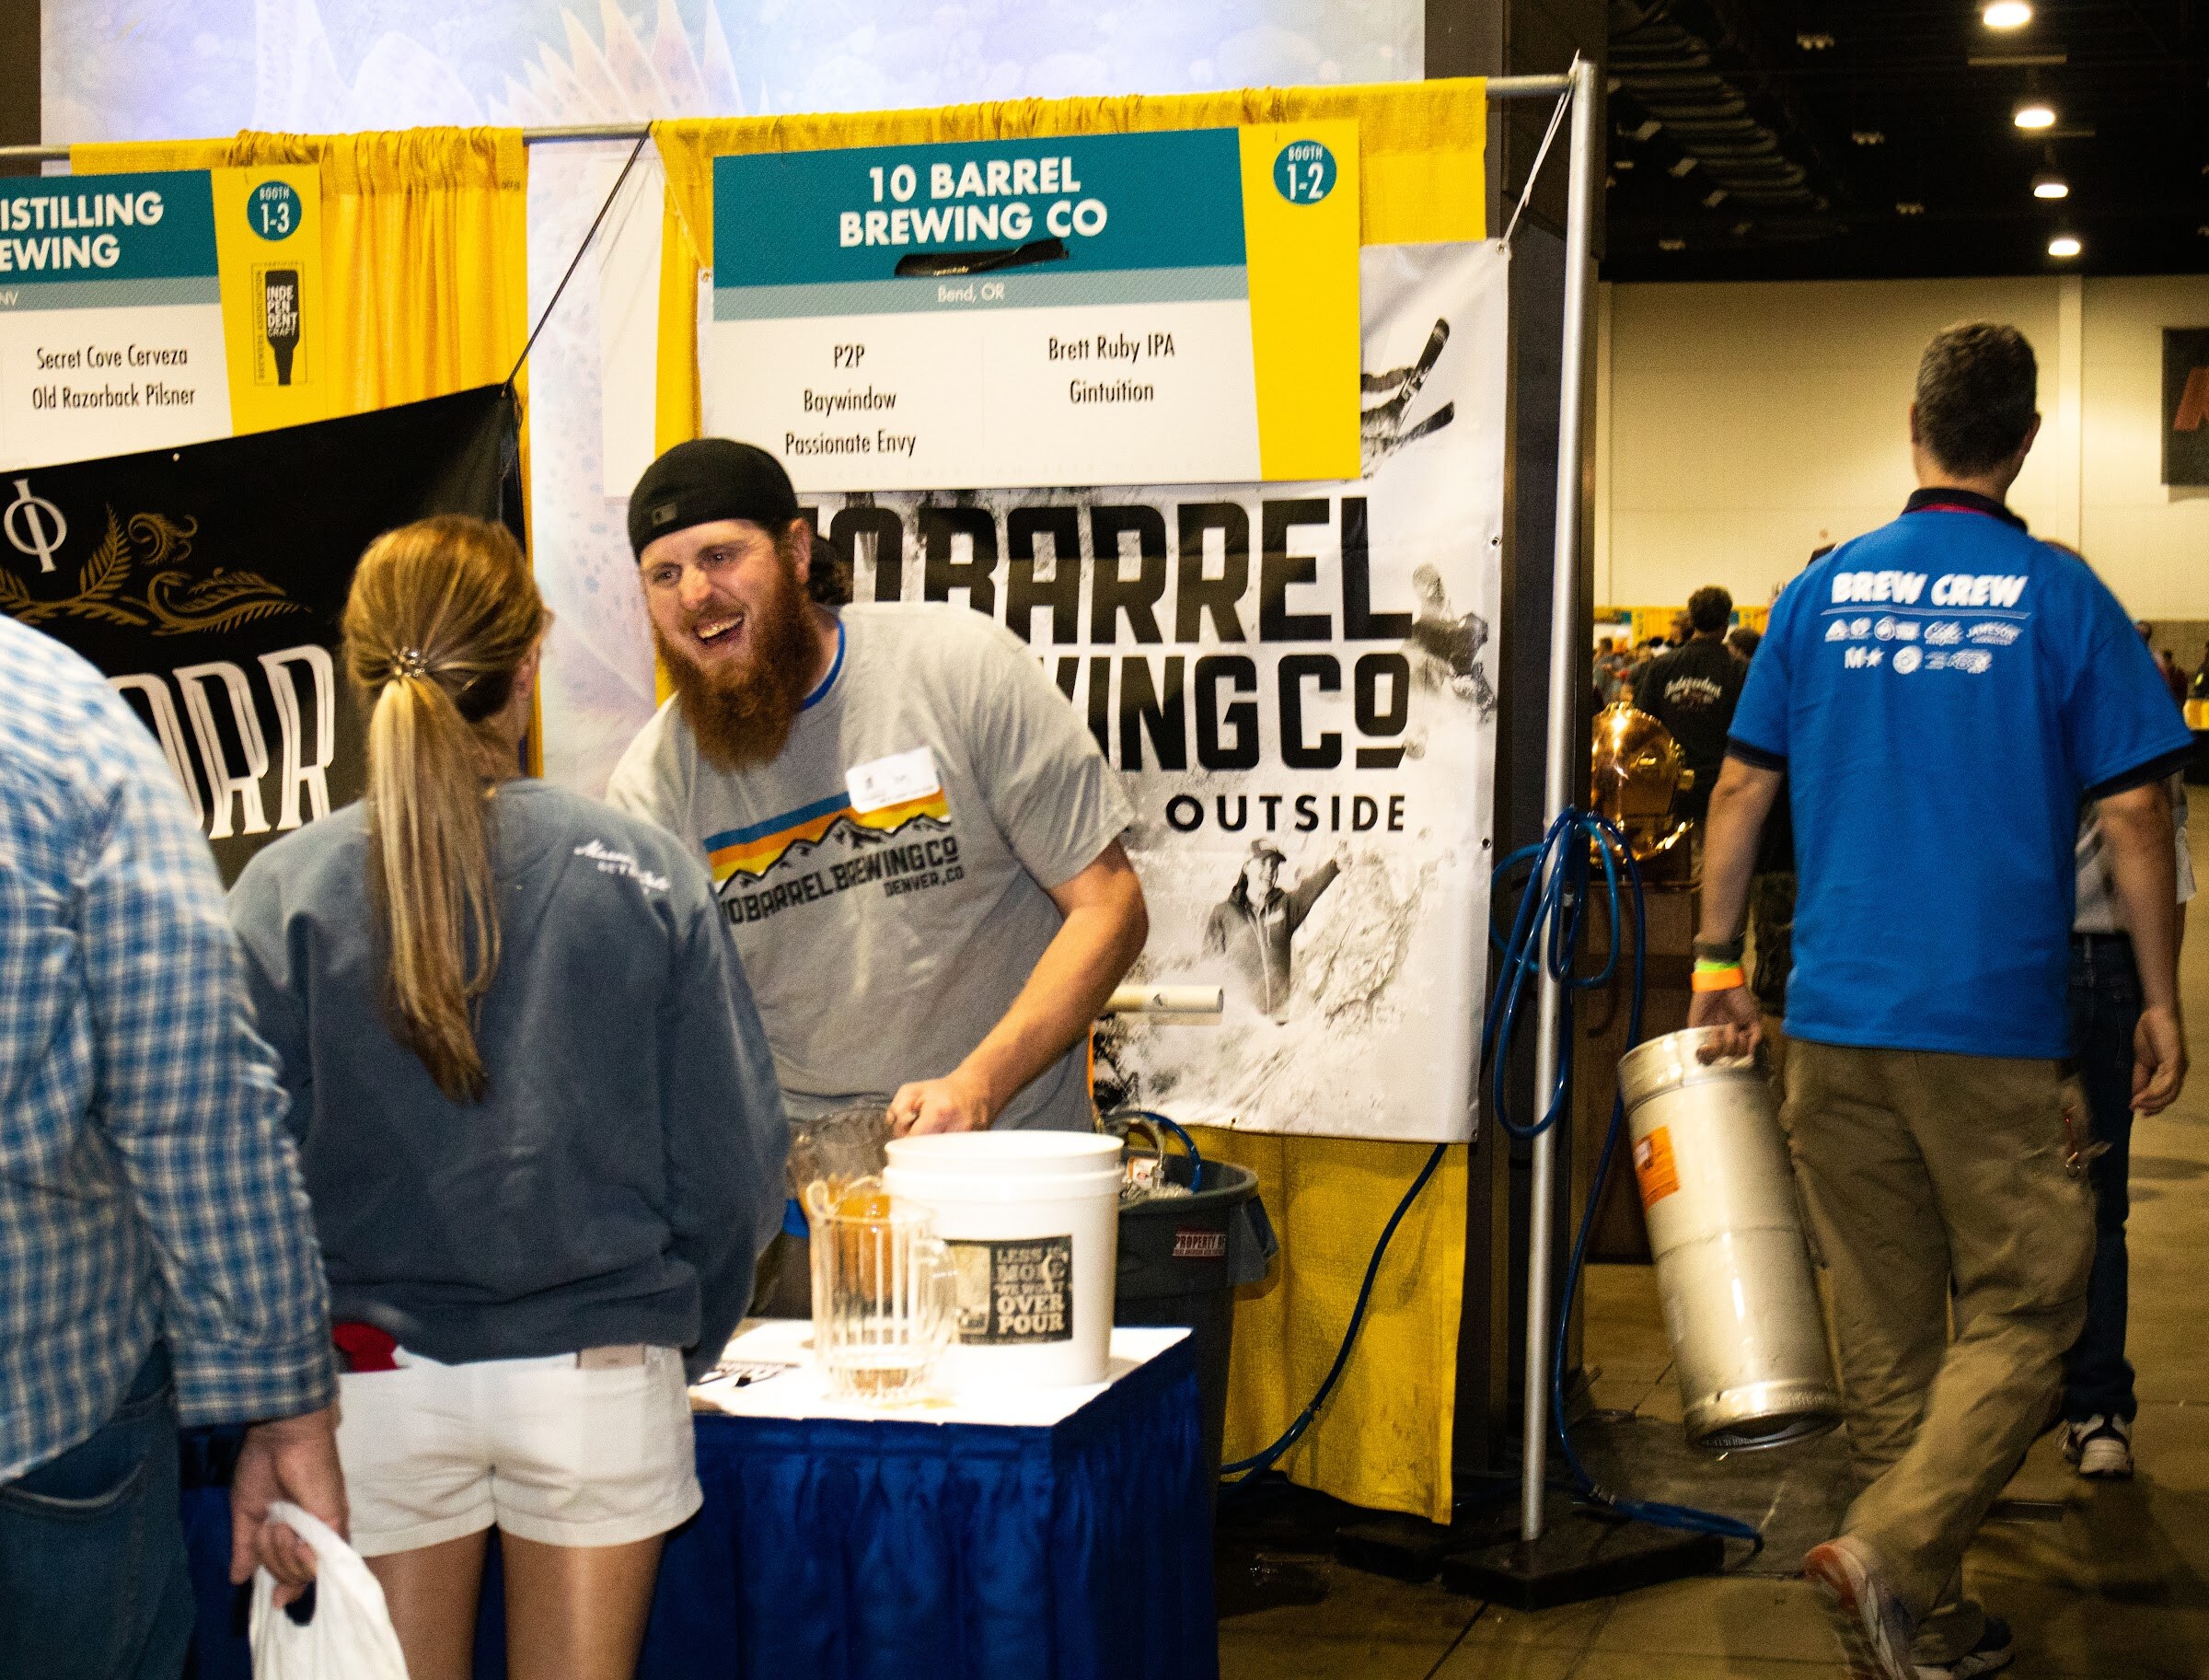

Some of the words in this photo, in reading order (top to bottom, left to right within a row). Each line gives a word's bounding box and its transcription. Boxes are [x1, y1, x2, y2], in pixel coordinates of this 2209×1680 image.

[1289, 145, 1323, 161] BOOTH
[260, 186, 290, 201] BOOTH
[869, 164, 917, 203] 10
[931, 156, 1081, 200] BARREL
[1287, 162, 1324, 200] 1-2
[1, 191, 164, 231] ISTILLING
[260, 203, 290, 234] 1-3
[839, 202, 1033, 247] BREWING
[1046, 198, 1107, 238] CO
[0, 233, 121, 272] EWING
[937, 283, 976, 304] Bend,
[981, 282, 1005, 301] OR
[37, 347, 81, 370] Secret
[87, 345, 121, 368] Cove
[128, 343, 189, 367] Cerveza
[833, 344, 865, 368] P2P
[1048, 337, 1090, 361] Brett
[1097, 333, 1140, 364] Ruby
[1147, 332, 1175, 358] IPA
[32, 385, 56, 410] Old
[63, 382, 139, 408] Razorback
[146, 380, 196, 407] Pilsner
[804, 386, 896, 417] Baywindow
[1070, 378, 1154, 404] Gintuition
[785, 432, 871, 457] Passionate
[876, 429, 917, 458] Envy
[799, 497, 1413, 644] 0BARREL
[1831, 571, 1928, 604] BREW
[1931, 574, 2029, 608] CREW
[1165, 794, 1405, 832] OUTSIDE
[997, 1247, 1042, 1265] LESS
[997, 1293, 1066, 1315] OVER
[998, 1313, 1066, 1336] POUR
